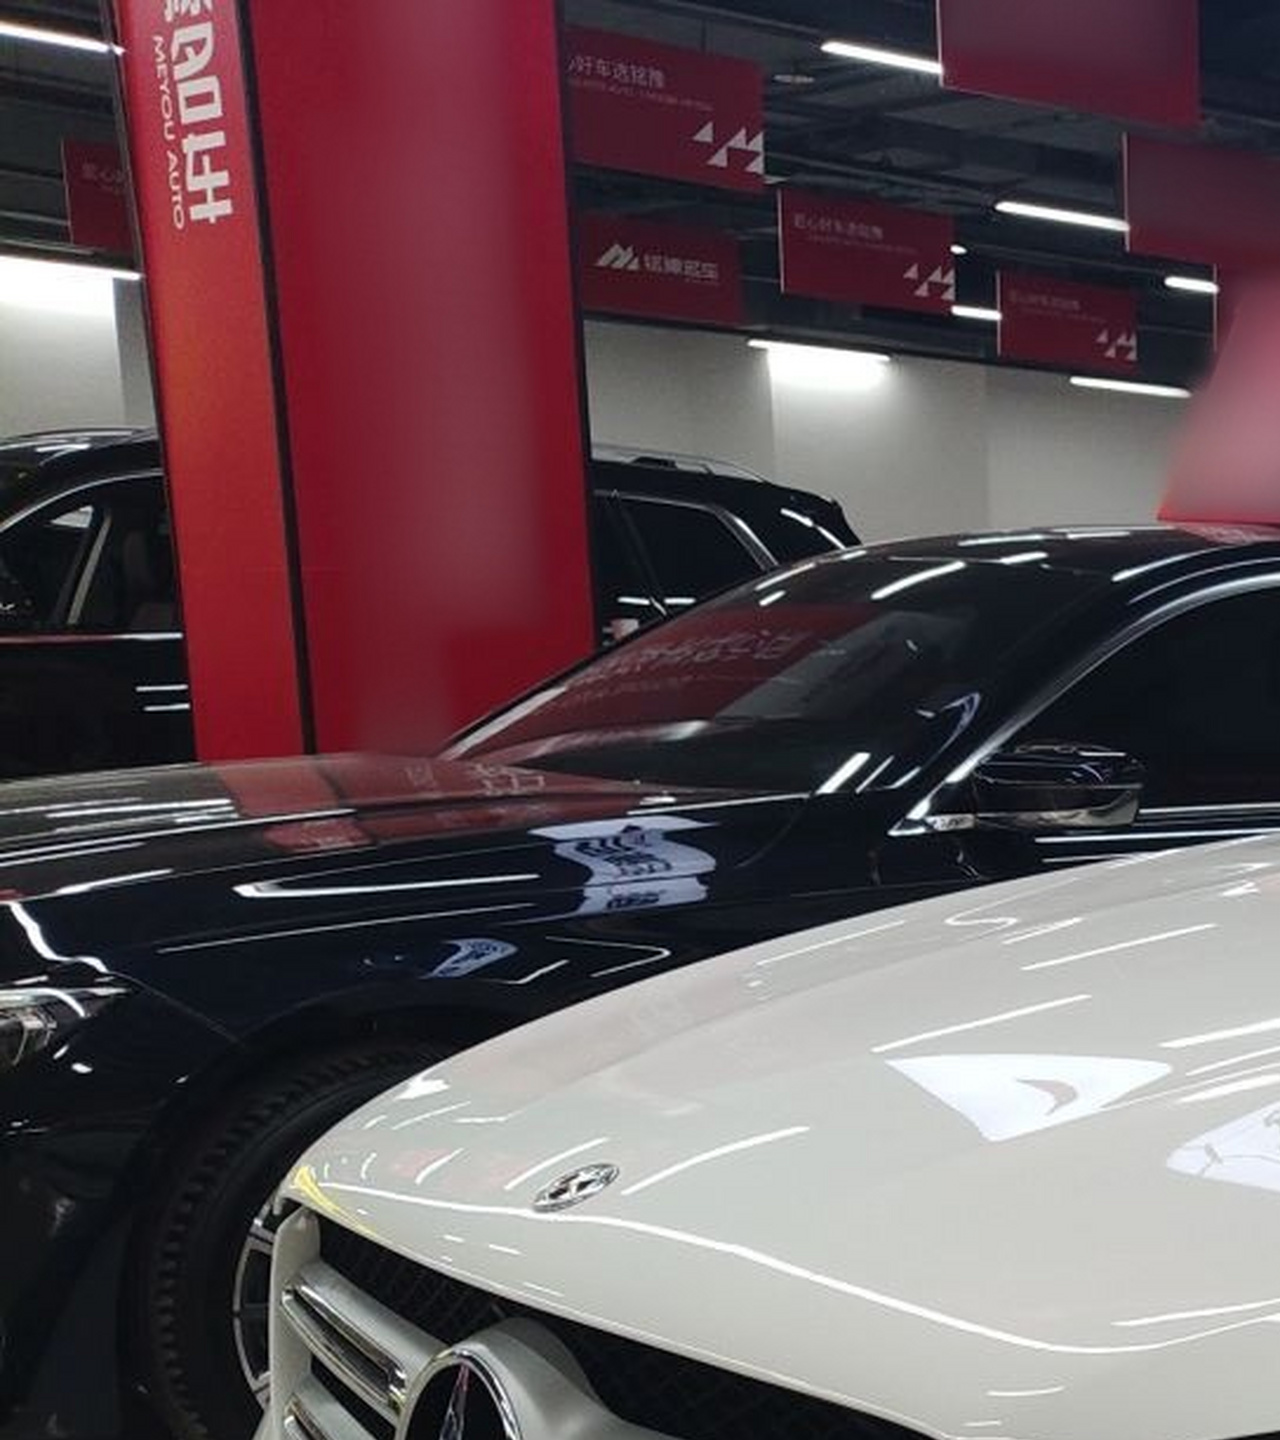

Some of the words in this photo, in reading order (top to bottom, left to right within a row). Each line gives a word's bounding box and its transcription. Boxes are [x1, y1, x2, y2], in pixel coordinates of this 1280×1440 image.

[153, 35, 177, 141] MEYOU
[166, 150, 185, 230] AUTO
[164, 0, 233, 224] 名车
